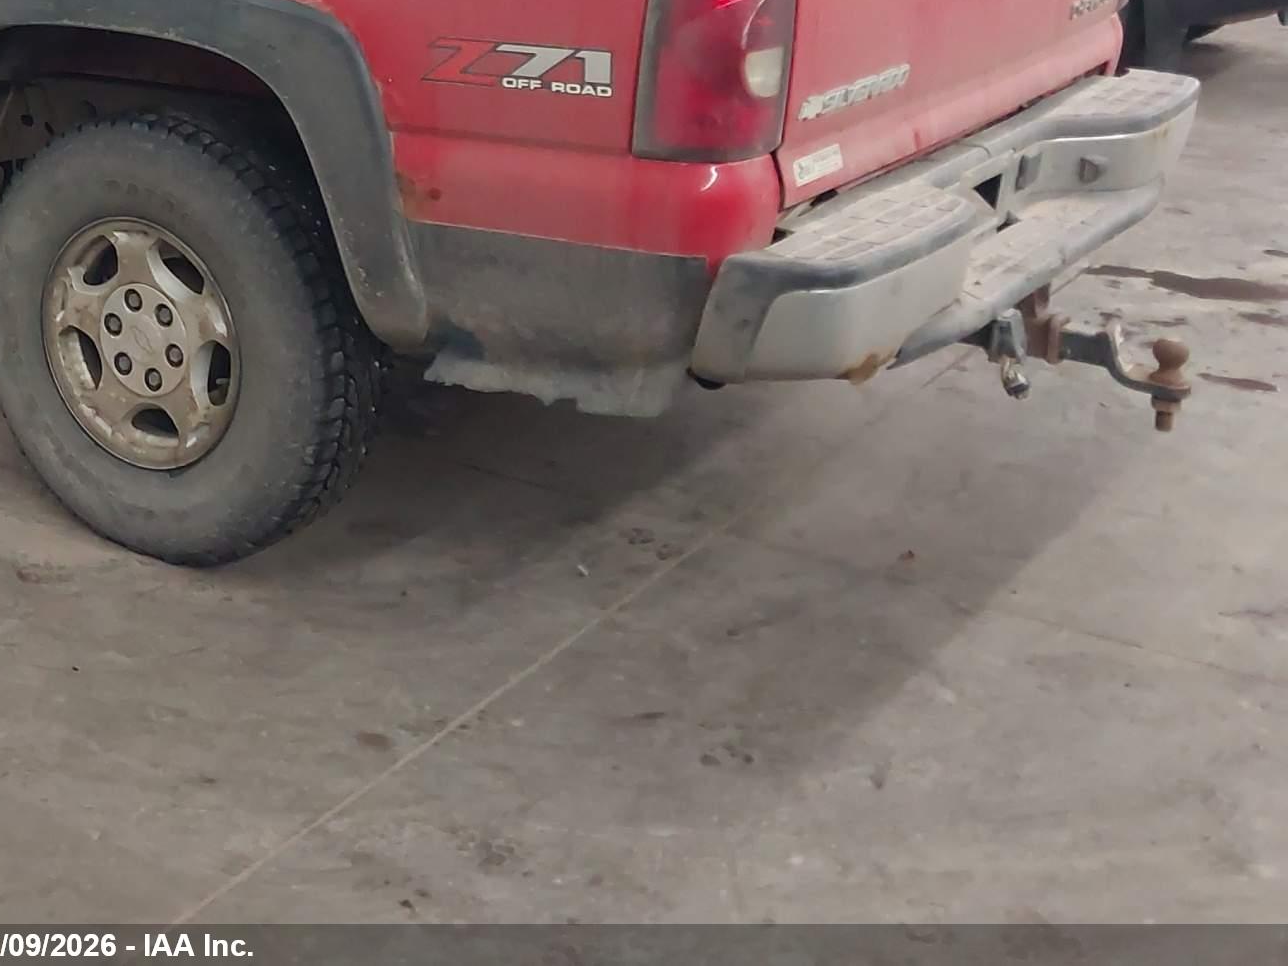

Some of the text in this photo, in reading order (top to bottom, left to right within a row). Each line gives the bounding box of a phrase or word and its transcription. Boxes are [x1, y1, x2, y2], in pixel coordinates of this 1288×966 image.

[420, 37, 612, 87] Z71
[501, 77, 612, 98] OFF ROAD
